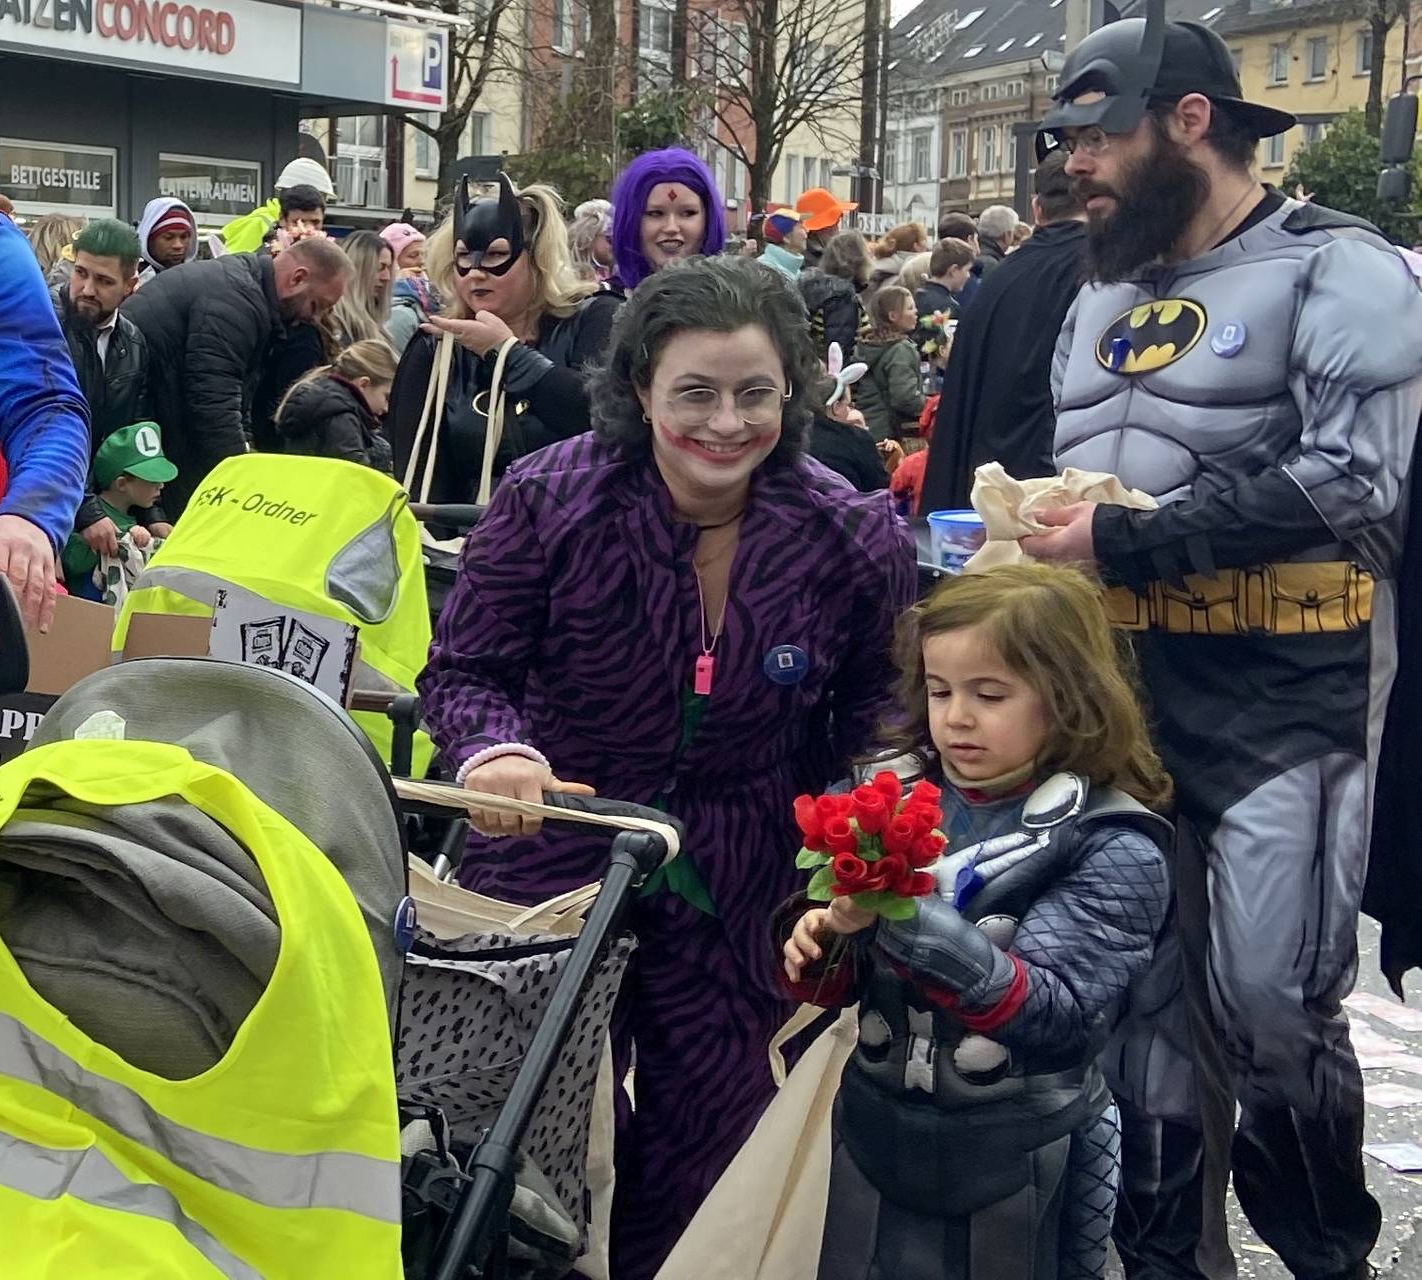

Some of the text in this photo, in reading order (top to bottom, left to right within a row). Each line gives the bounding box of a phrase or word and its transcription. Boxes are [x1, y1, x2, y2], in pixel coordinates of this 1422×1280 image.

[95, 0, 235, 54] CONCORD
[424, 38, 441, 82] P
[10, 164, 101, 190] BETTGESTELLE
[159, 177, 256, 203] LATTENRAHMEN
[839, 214, 882, 233] KOSK
[141, 431, 157, 452] L
[241, 493, 318, 526] Ordner
